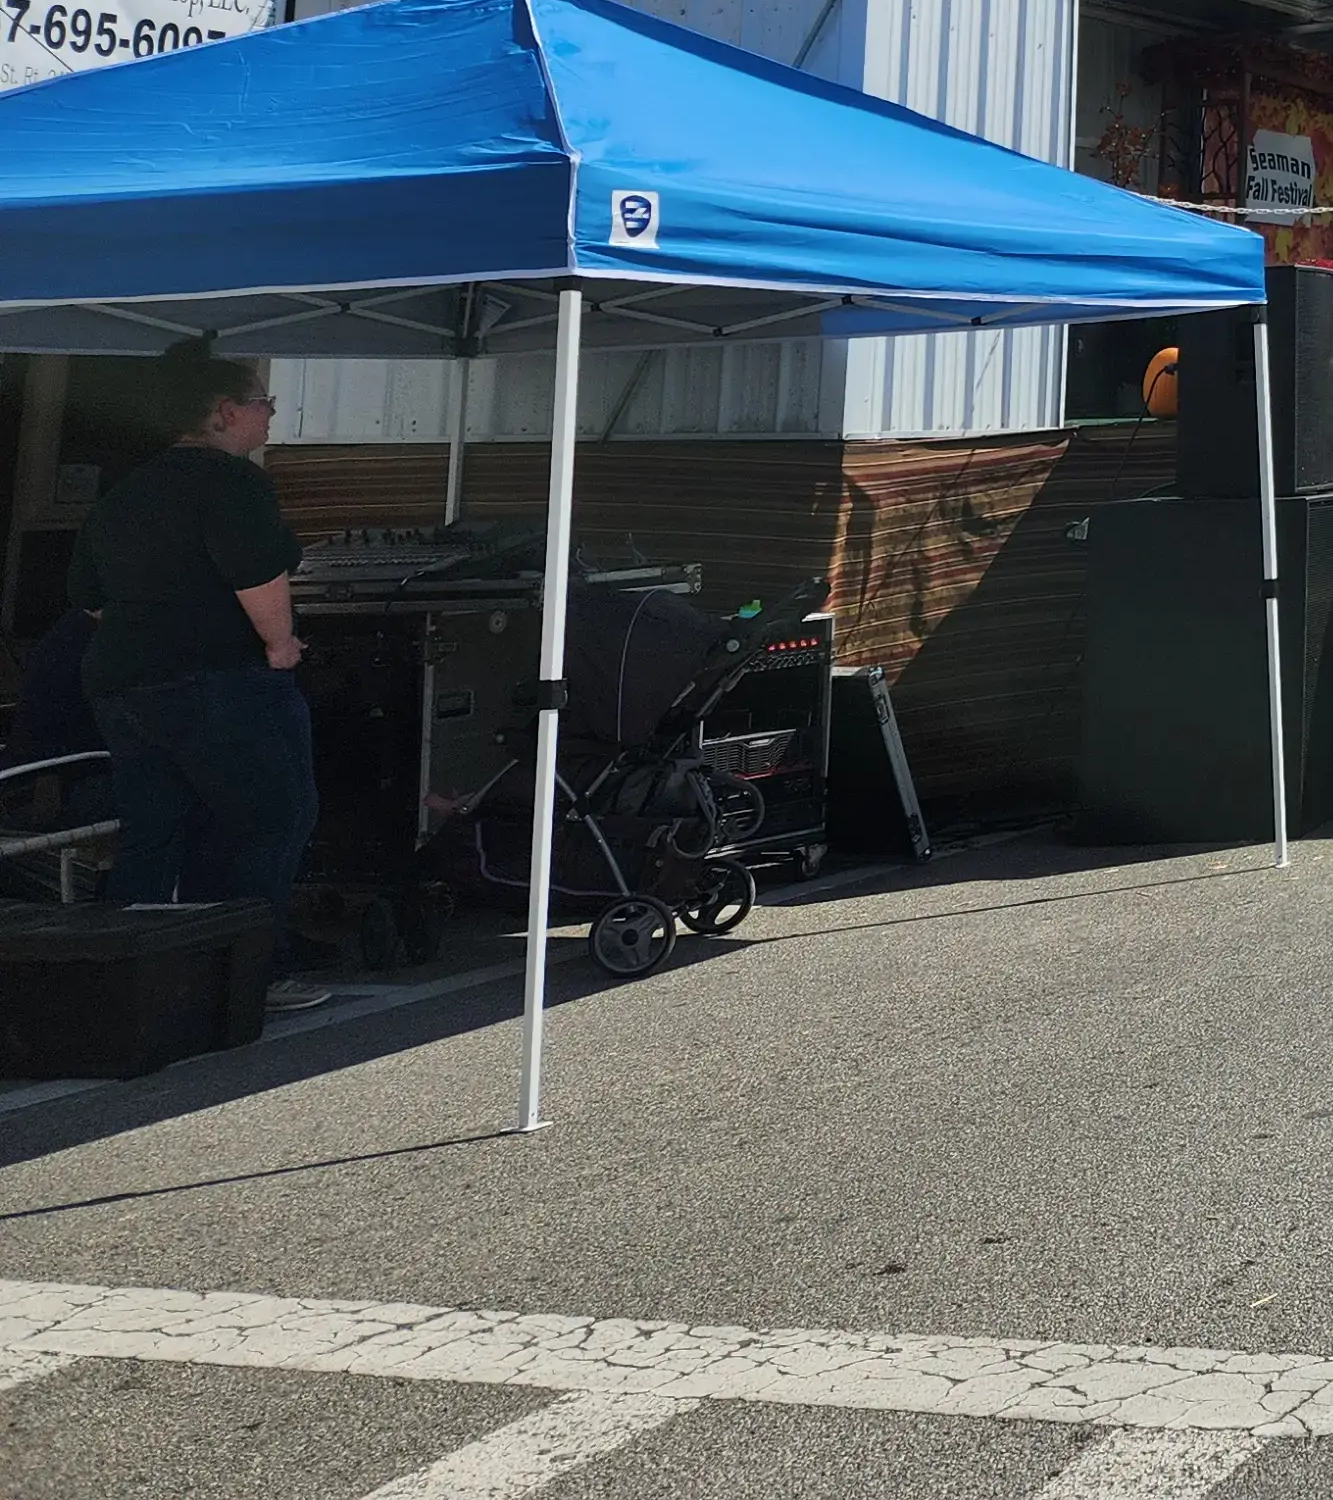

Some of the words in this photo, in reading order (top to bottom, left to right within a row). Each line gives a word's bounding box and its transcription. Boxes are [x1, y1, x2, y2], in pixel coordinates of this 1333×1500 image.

[1249, 147, 1312, 180] Seaman
[1246, 175, 1269, 202] Fall
[1270, 178, 1313, 208] Festival
